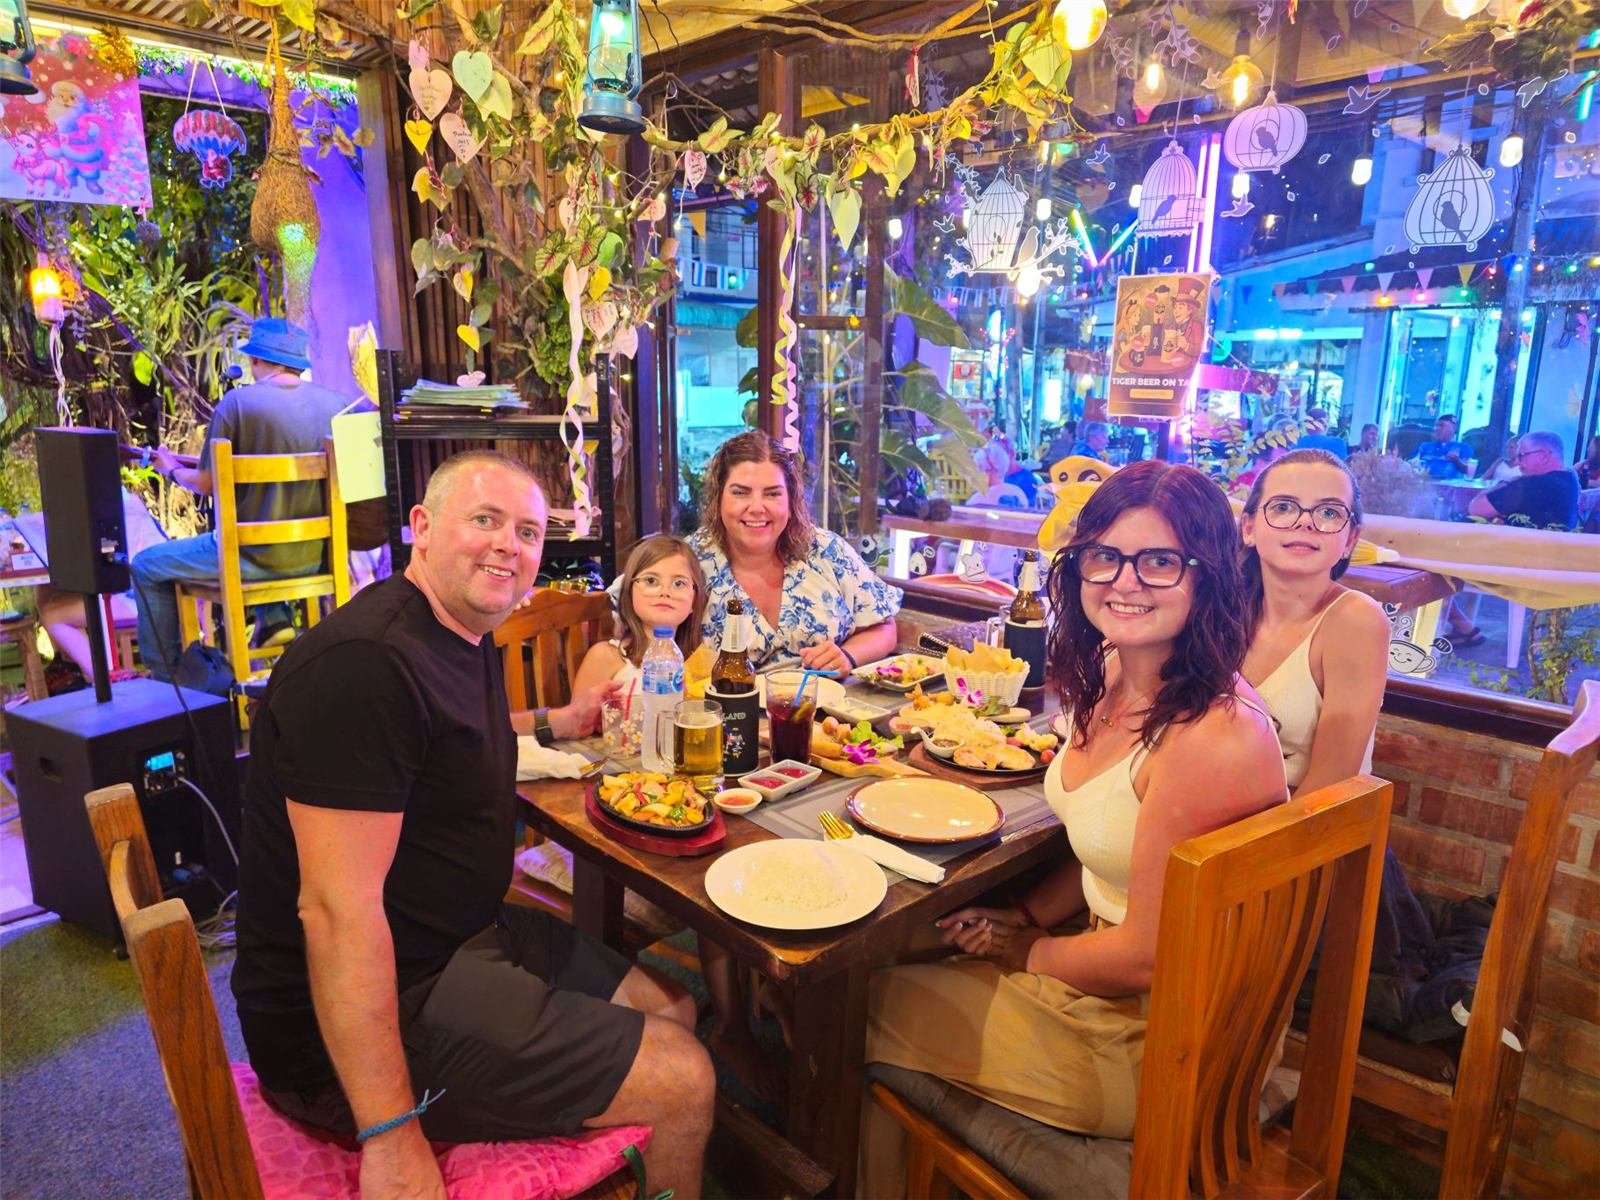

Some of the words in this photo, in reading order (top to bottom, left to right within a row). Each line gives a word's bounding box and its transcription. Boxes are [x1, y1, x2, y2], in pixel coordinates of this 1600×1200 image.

[1112, 377, 1136, 386] TIGER
[1137, 378, 1161, 386] BEER
[1162, 378, 1176, 387] ON
[1178, 379, 1189, 387] TA
[722, 712, 747, 721] LAND
